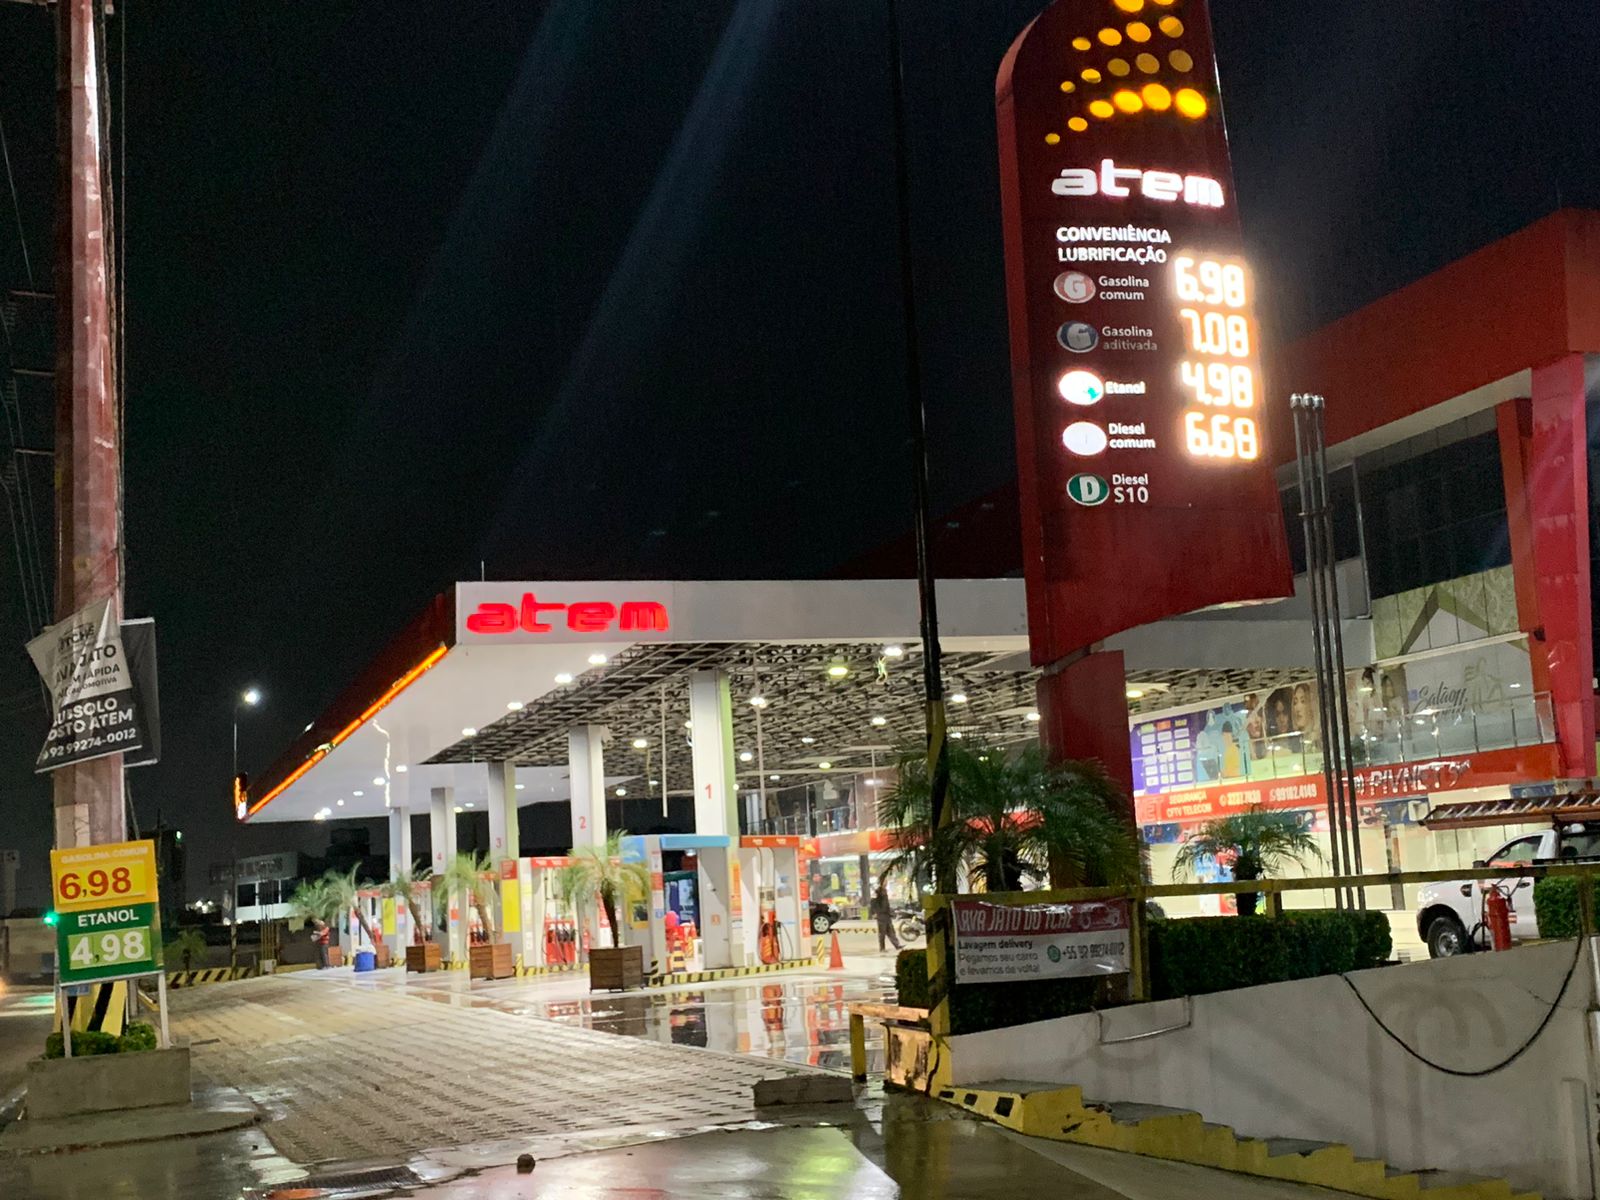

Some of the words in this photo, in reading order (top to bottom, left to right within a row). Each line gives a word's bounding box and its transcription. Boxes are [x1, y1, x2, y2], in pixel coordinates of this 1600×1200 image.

[1051, 158, 1225, 207] atem
[1056, 224, 1171, 243] CONVENIÊNCIA
[1058, 246, 1167, 265] LUBRIFICAÇÃO
[1099, 275, 1150, 288] Gasolina
[1174, 256, 1246, 307] 6.98
[1099, 289, 1144, 301] comum
[1102, 325, 1153, 338] Gasolina
[1103, 338, 1158, 351] aditivada
[1105, 381, 1145, 395] Etanol
[1108, 422, 1145, 435] Diesel
[1109, 437, 1156, 449] comum
[1112, 473, 1149, 486] Diesel
[1079, 476, 1100, 501] D
[1114, 487, 1149, 503] S10
[466, 591, 669, 634] atem
[79, 644, 117, 667] JATO
[89, 708, 133, 731] ATEM
[50, 745, 64, 757] 92
[66, 728, 136, 754] 99274-0012
[705, 784, 713, 799] 1
[579, 817, 586, 829] 2
[496, 837, 502, 849] 3
[59, 867, 132, 900] 6,98
[77, 909, 139, 927] ETANOL
[957, 909, 986, 931] LAVA
[987, 908, 1020, 931] JATO
[70, 931, 145, 965] 4,98
[959, 940, 997, 952] Lavagem
[998, 938, 1033, 950] delivery
[1000, 954, 1014, 962] seu
[1015, 953, 1038, 961] carro
